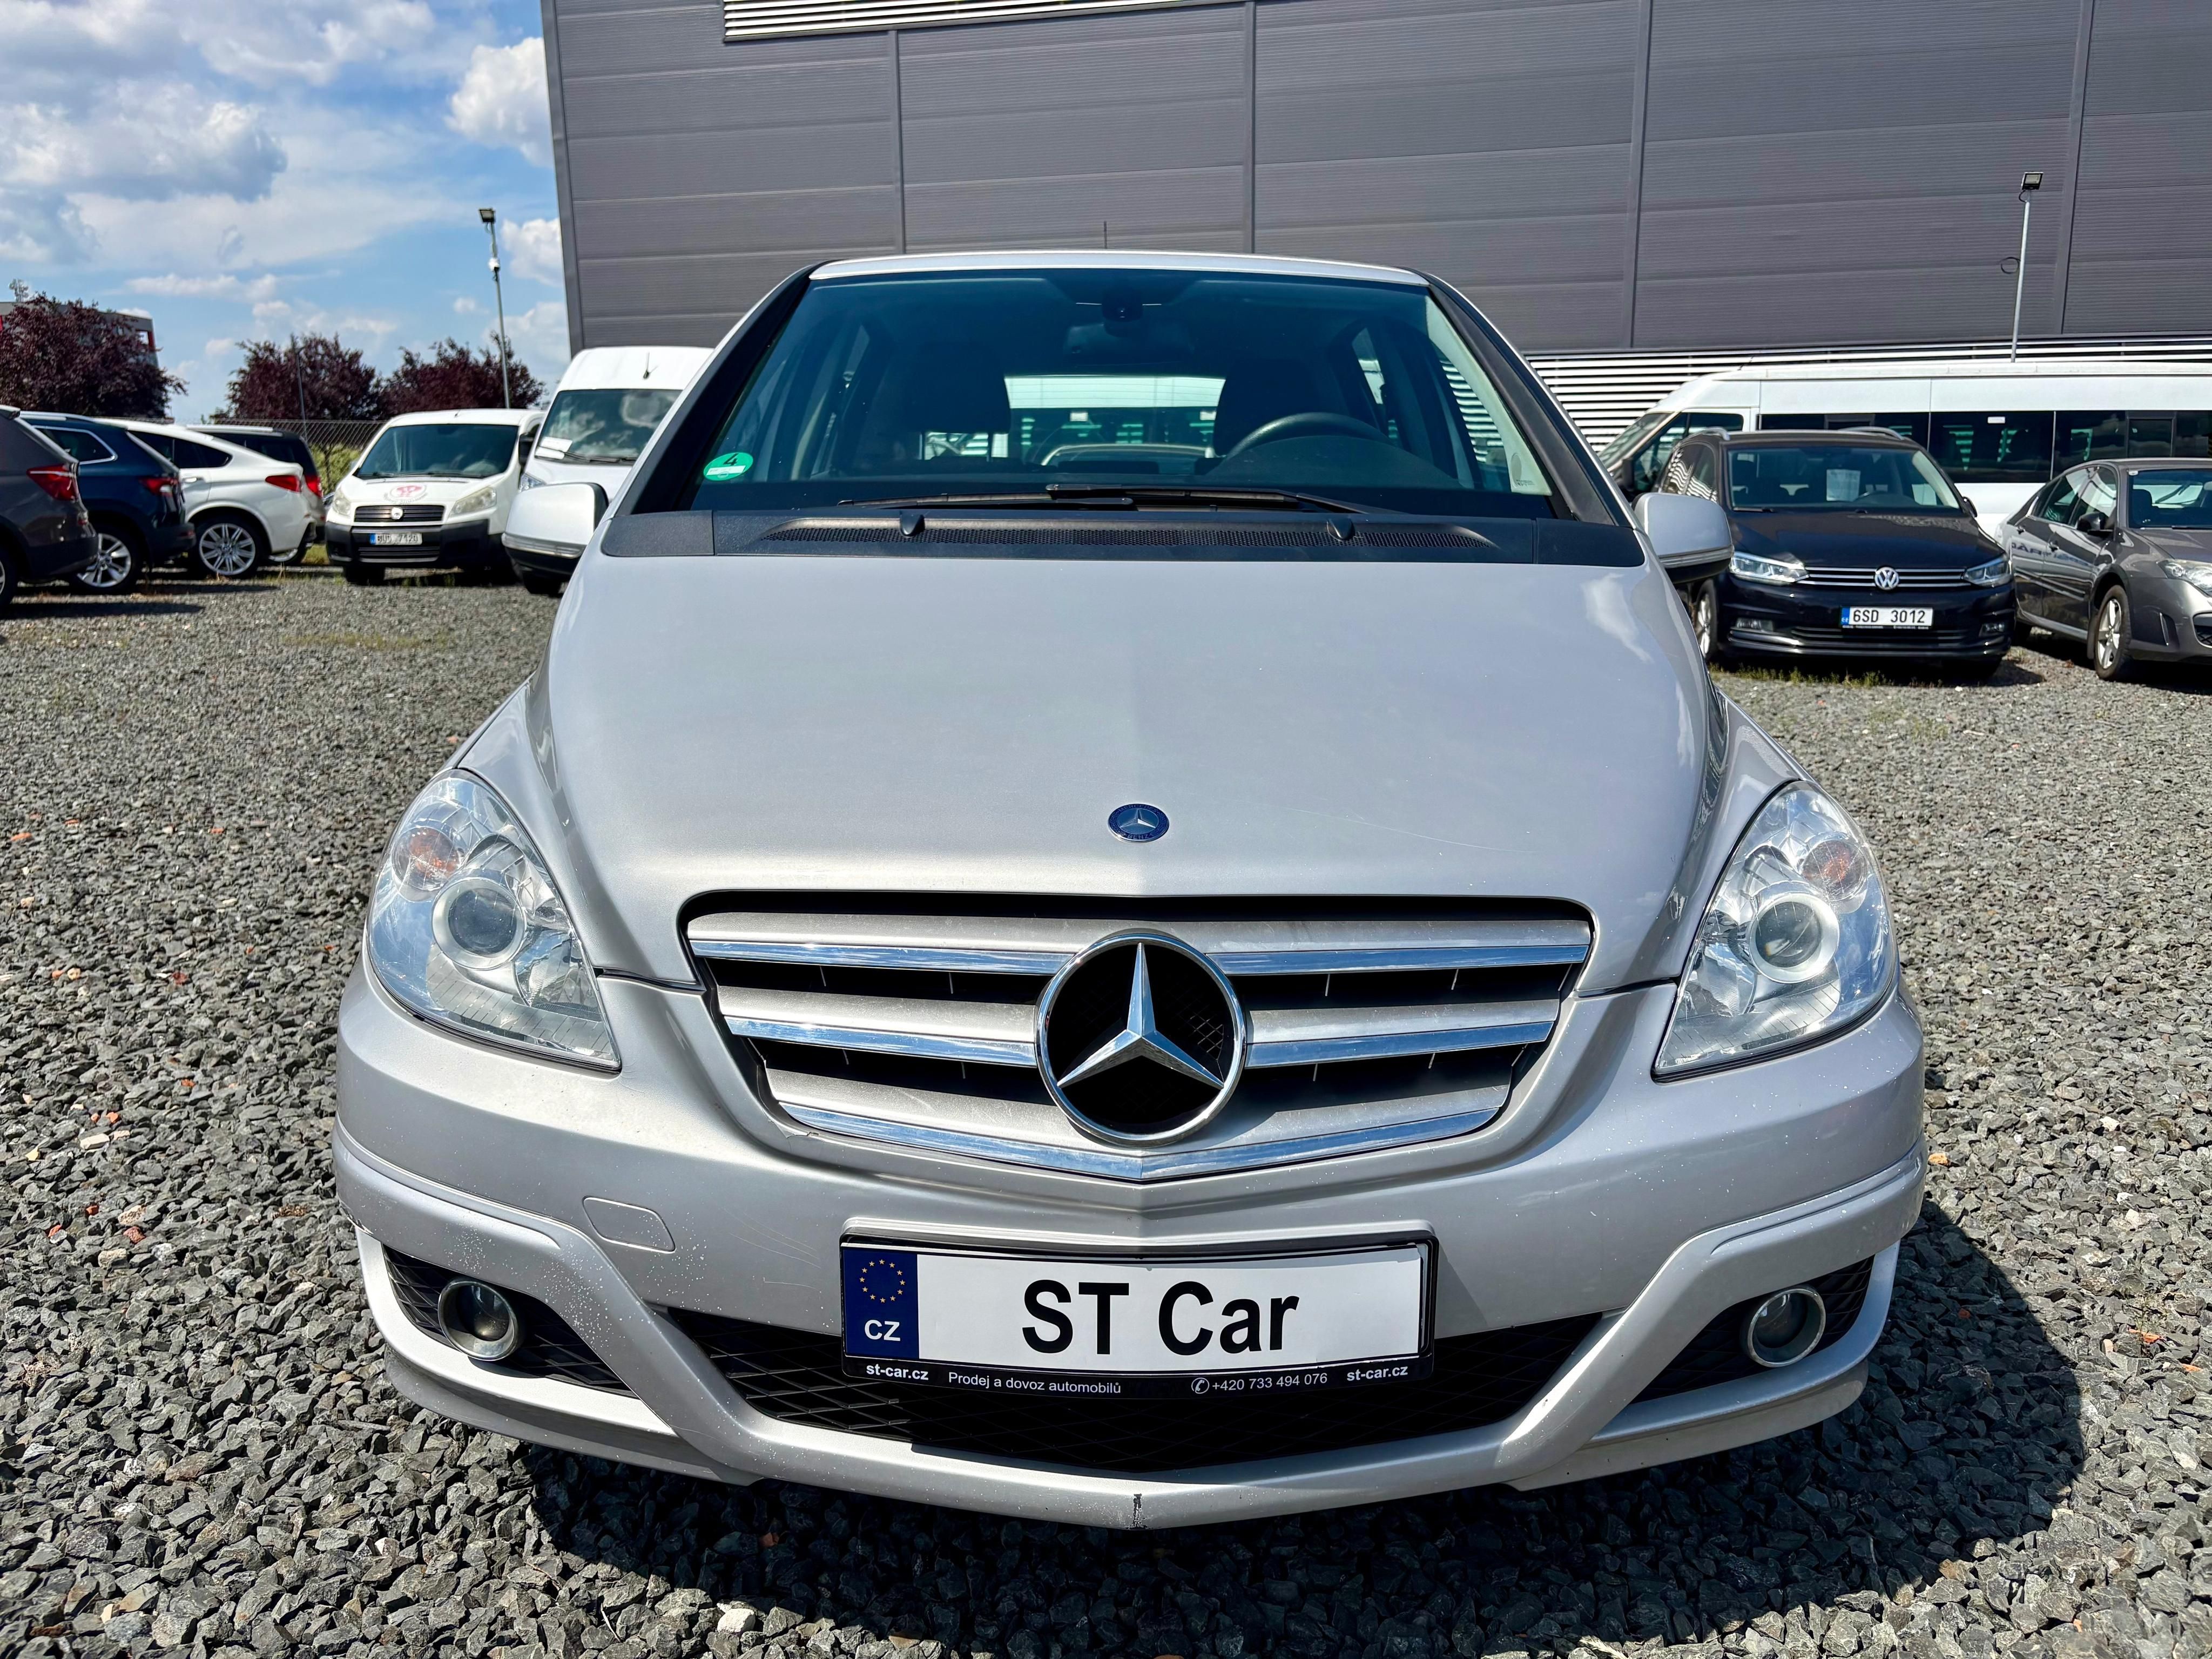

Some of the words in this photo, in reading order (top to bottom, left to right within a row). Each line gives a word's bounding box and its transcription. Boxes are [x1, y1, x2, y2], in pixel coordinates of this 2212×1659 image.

[724, 453, 739, 466] 4
[1853, 610, 1879, 622] 6SD
[1891, 611, 1925, 623] 3012
[1118, 804, 1158, 813] MERCEDES
[1022, 1280, 1129, 1354] ST
[1159, 1282, 1299, 1355] Car
[865, 1320, 900, 1341] CZ
[866, 1364, 929, 1380] st-car.cz
[1347, 1366, 1408, 1381] st-car.cz
[949, 1372, 989, 1388] Prodej
[994, 1379, 1002, 1387] a
[1006, 1378, 1044, 1390] dovoz
[1049, 1381, 1121, 1393] automobilů
[1212, 1379, 1244, 1391] +420
[1249, 1378, 1272, 1389] 733
[1276, 1375, 1300, 1387] 494
[1304, 1373, 1327, 1385] 076
